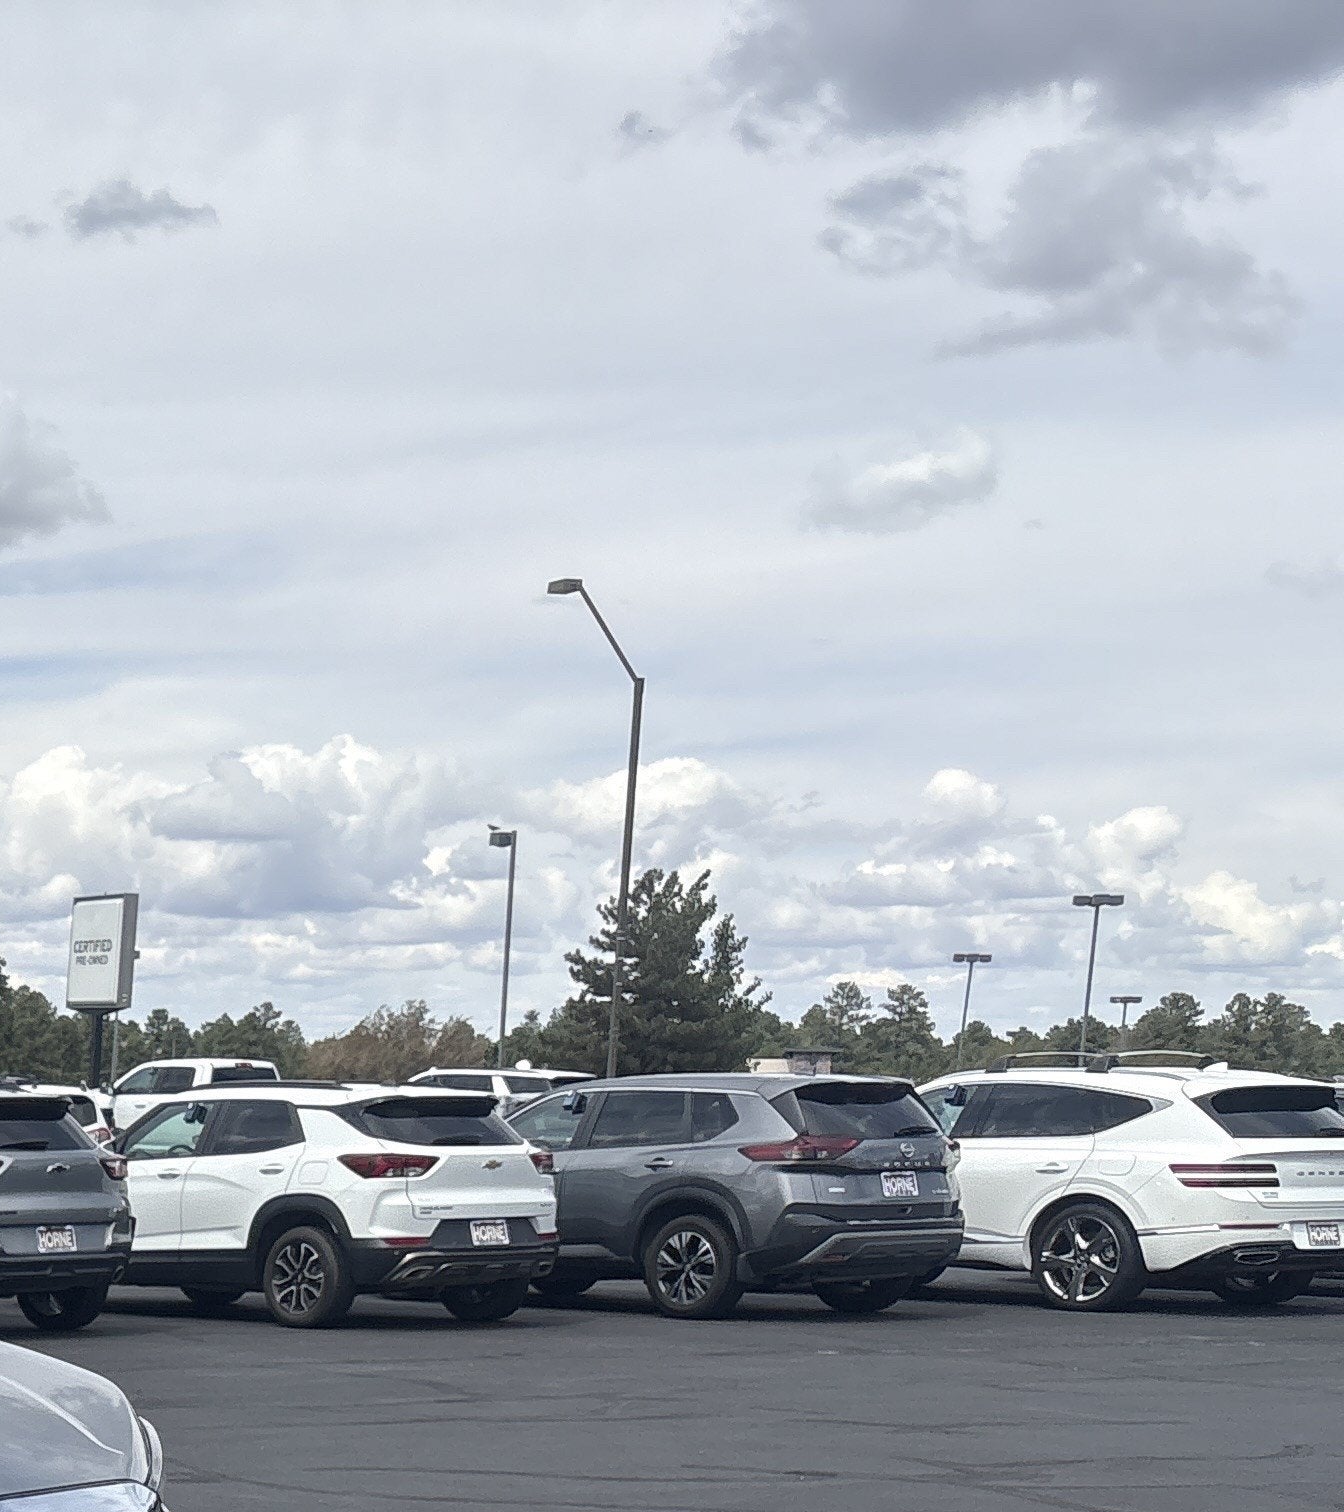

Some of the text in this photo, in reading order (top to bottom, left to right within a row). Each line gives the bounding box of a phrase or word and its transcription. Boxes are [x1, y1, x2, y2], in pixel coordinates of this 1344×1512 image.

[883, 1177, 915, 1191] HORNE
[39, 1230, 73, 1248] HORNE
[474, 1225, 506, 1240] HORNE
[1309, 1227, 1339, 1241] HORNE
